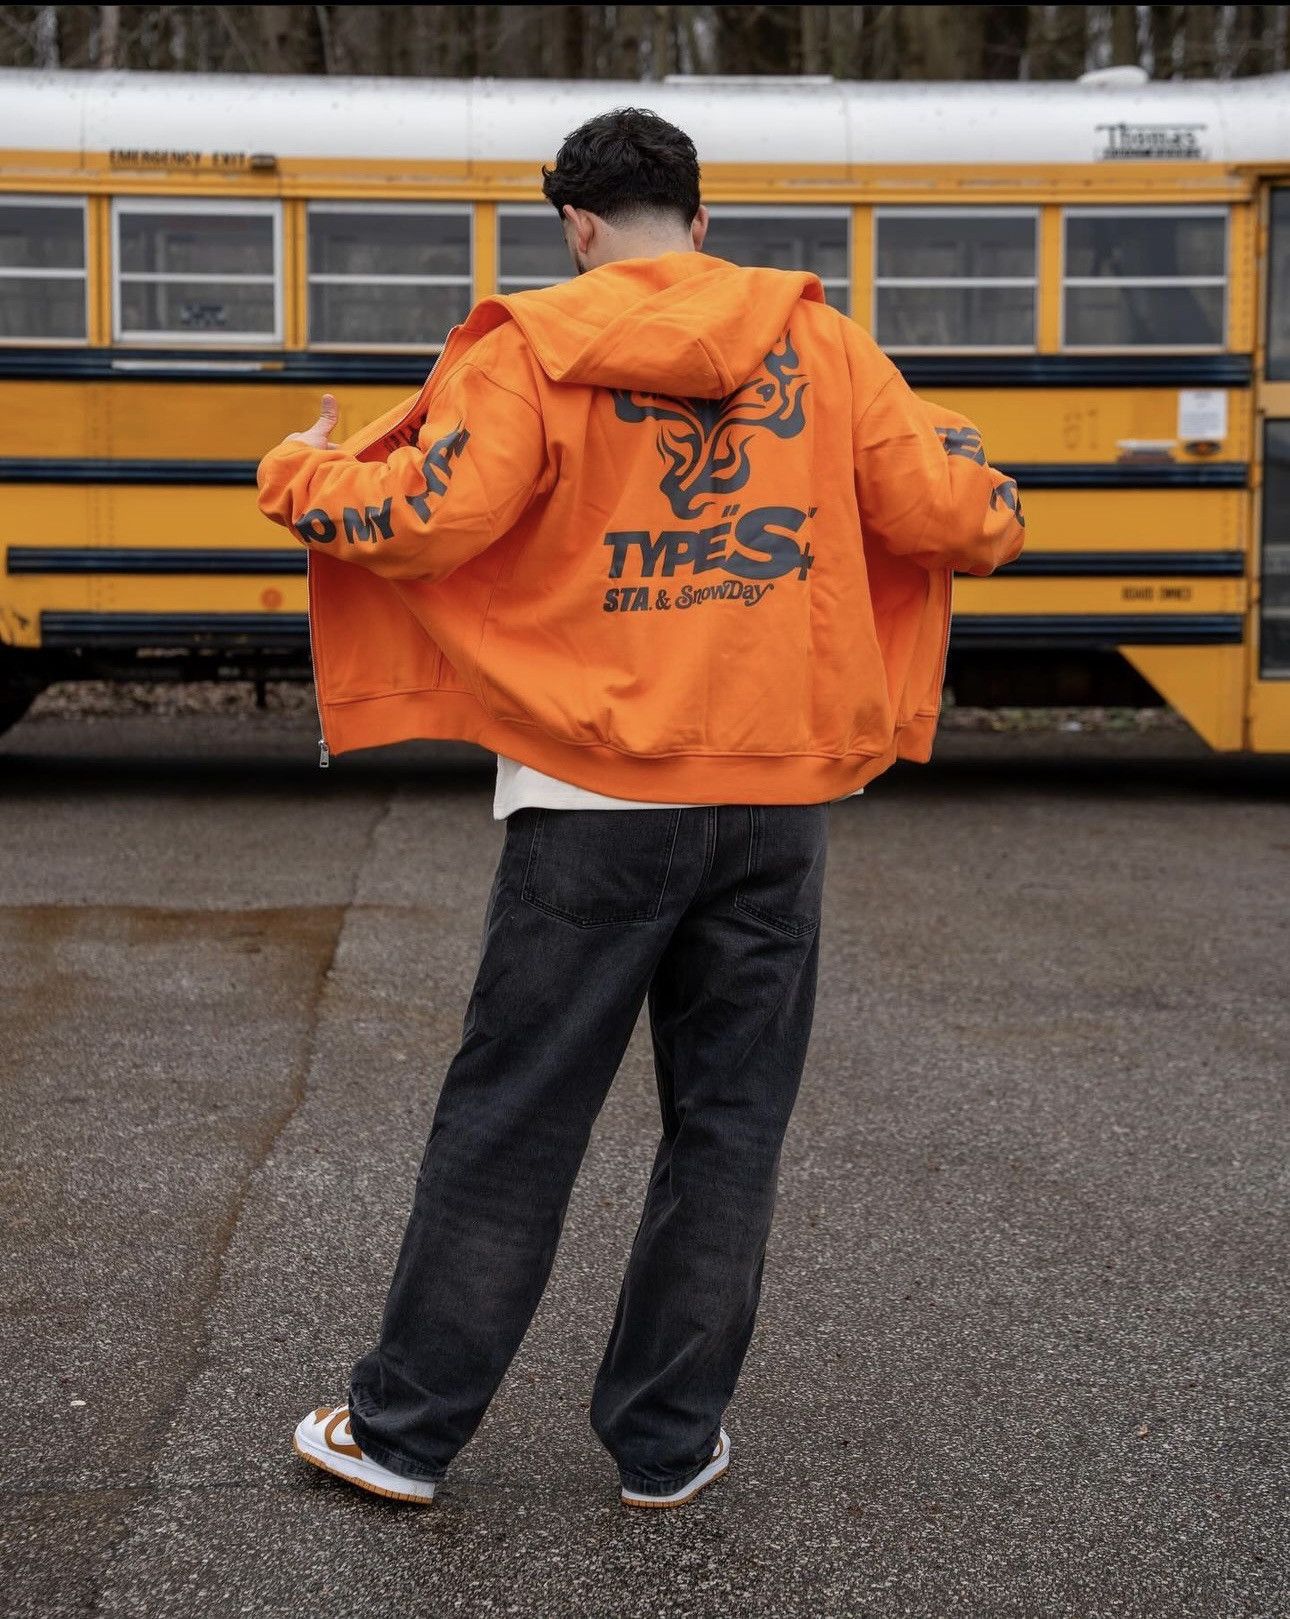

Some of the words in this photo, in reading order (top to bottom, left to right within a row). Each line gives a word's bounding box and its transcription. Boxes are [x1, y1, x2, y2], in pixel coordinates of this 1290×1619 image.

[1095, 122, 1207, 148] Thomas
[109, 149, 202, 166] EMERGENCY
[212, 151, 246, 167] EXIT
[343, 496, 394, 544] MY
[655, 589, 672, 611] &
